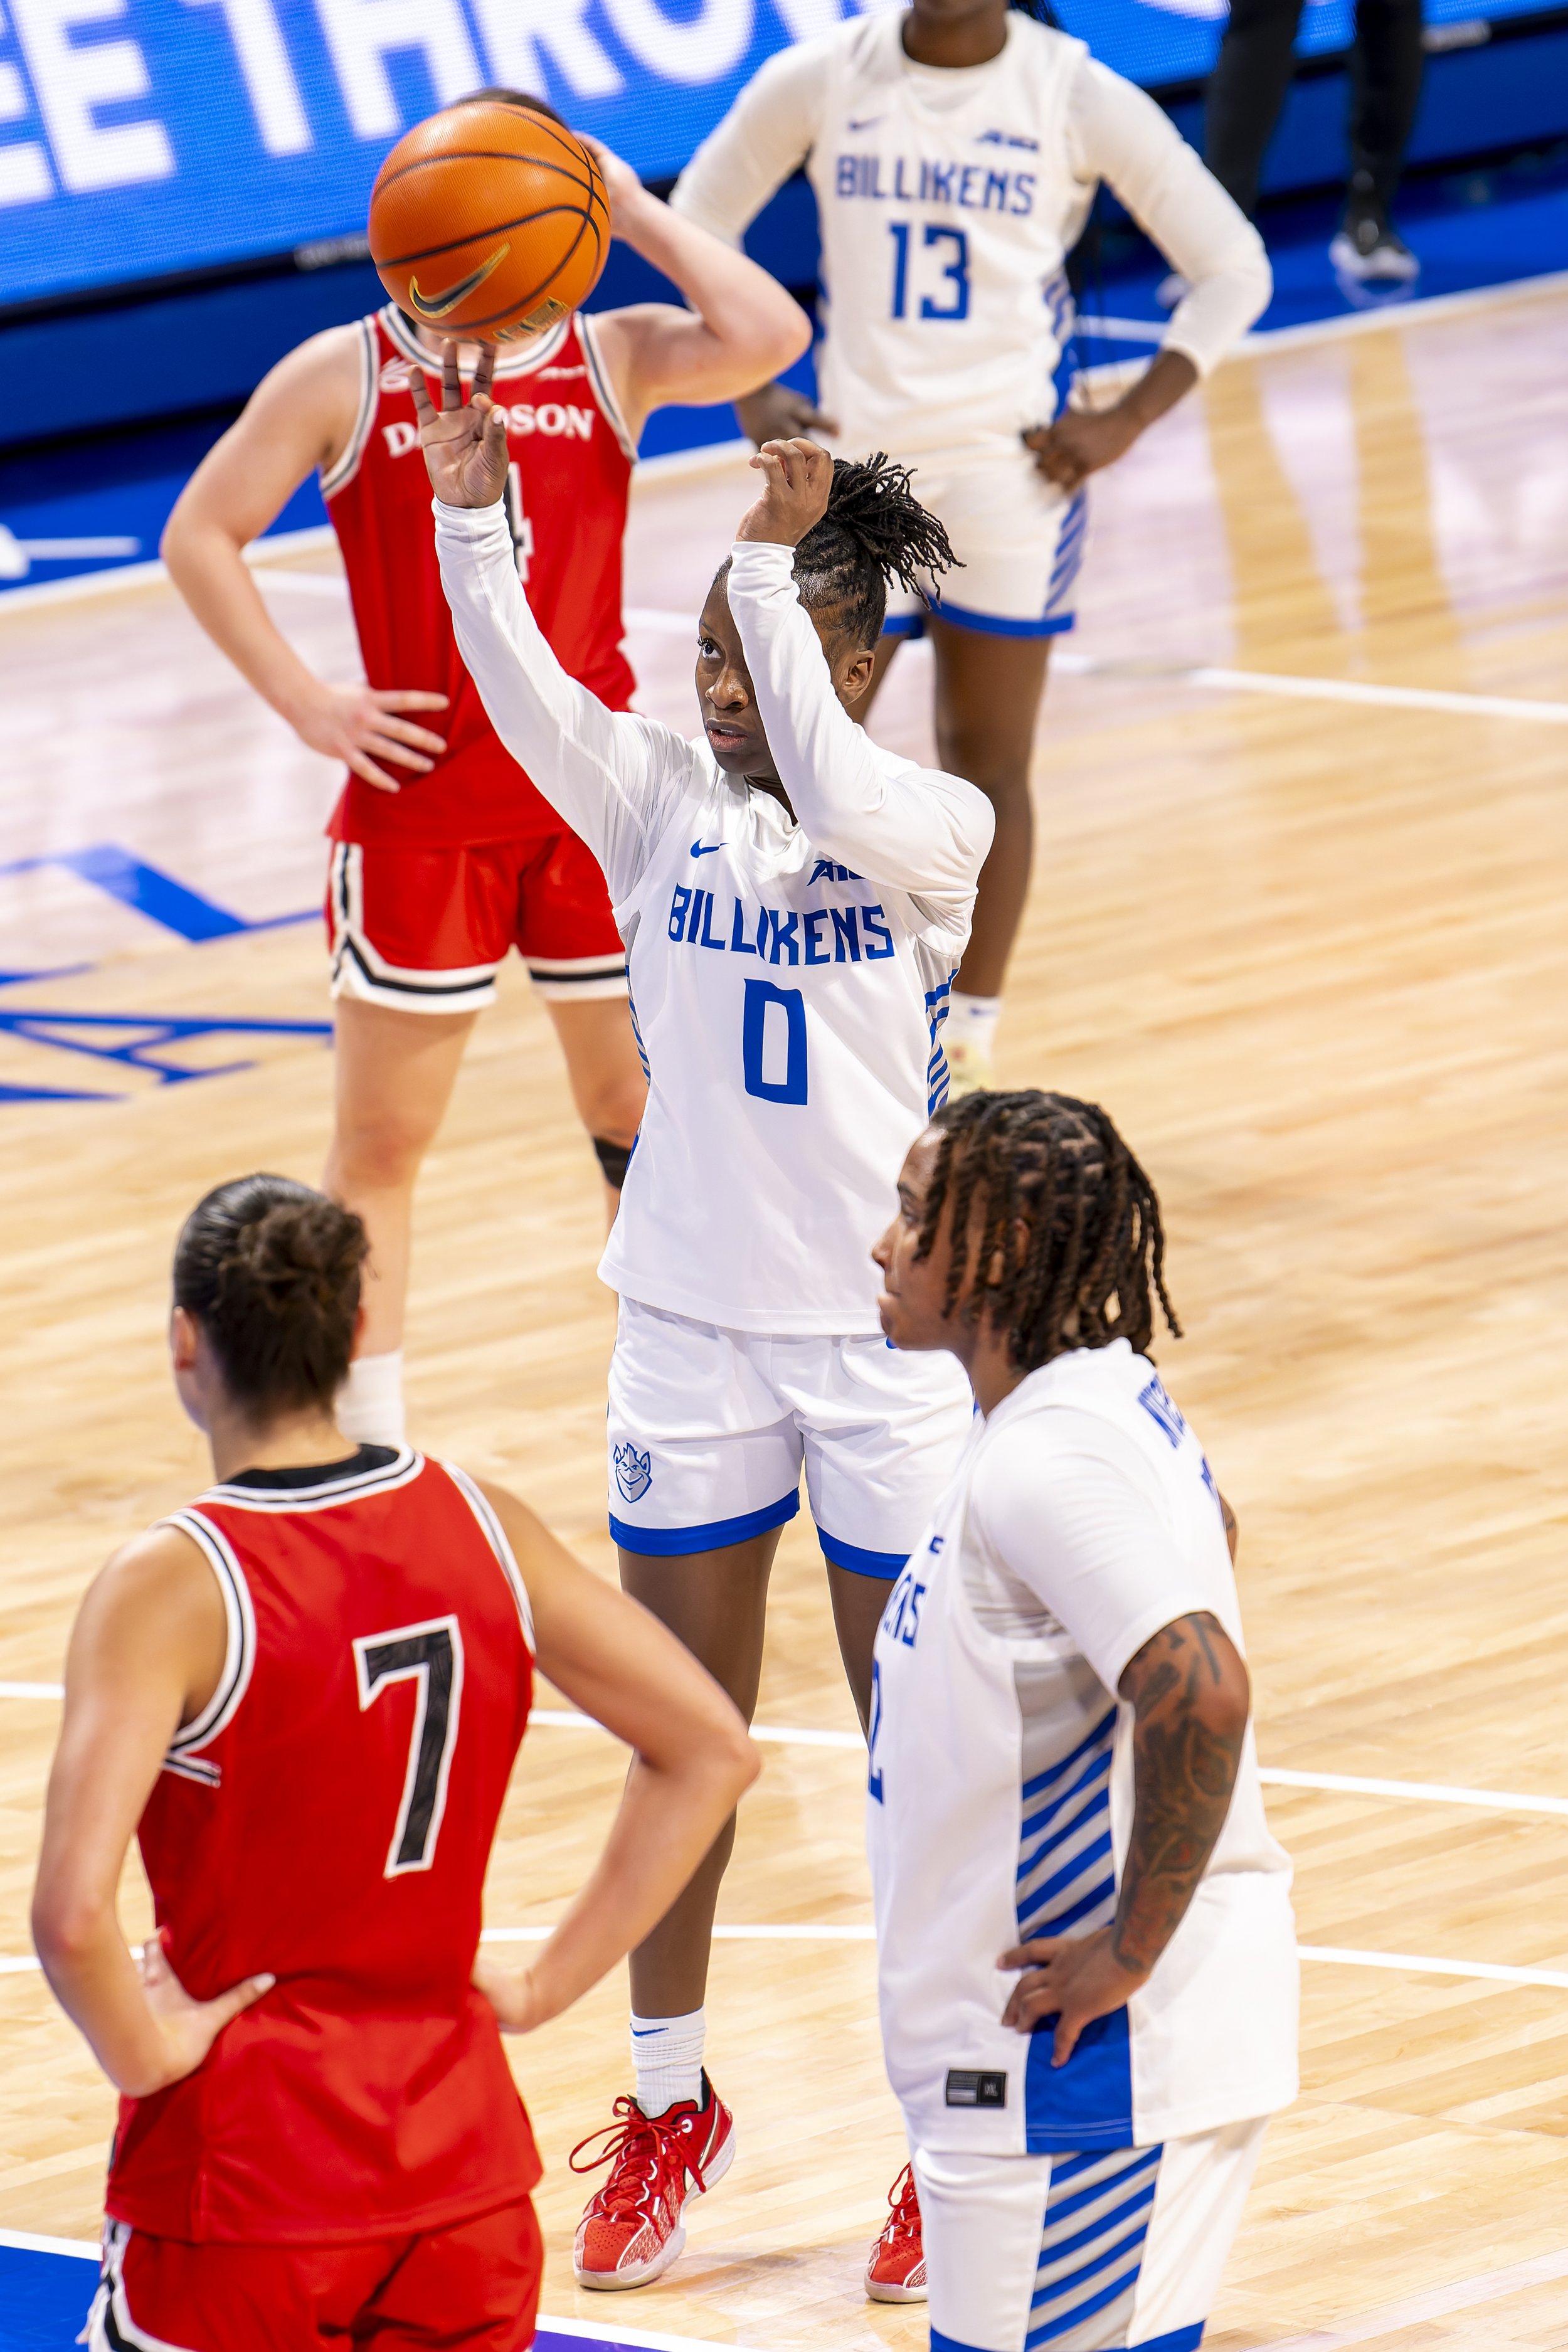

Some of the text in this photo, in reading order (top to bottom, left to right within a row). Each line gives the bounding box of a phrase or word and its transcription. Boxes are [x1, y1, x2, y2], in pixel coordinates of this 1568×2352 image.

[837, 156, 1036, 216] BILLIKENS
[888, 221, 970, 320] 13
[381, 403, 595, 459] DSON
[668, 882, 895, 966] BILLIKENS
[743, 978, 808, 1106] 0
[352, 1614, 465, 1880] 7
